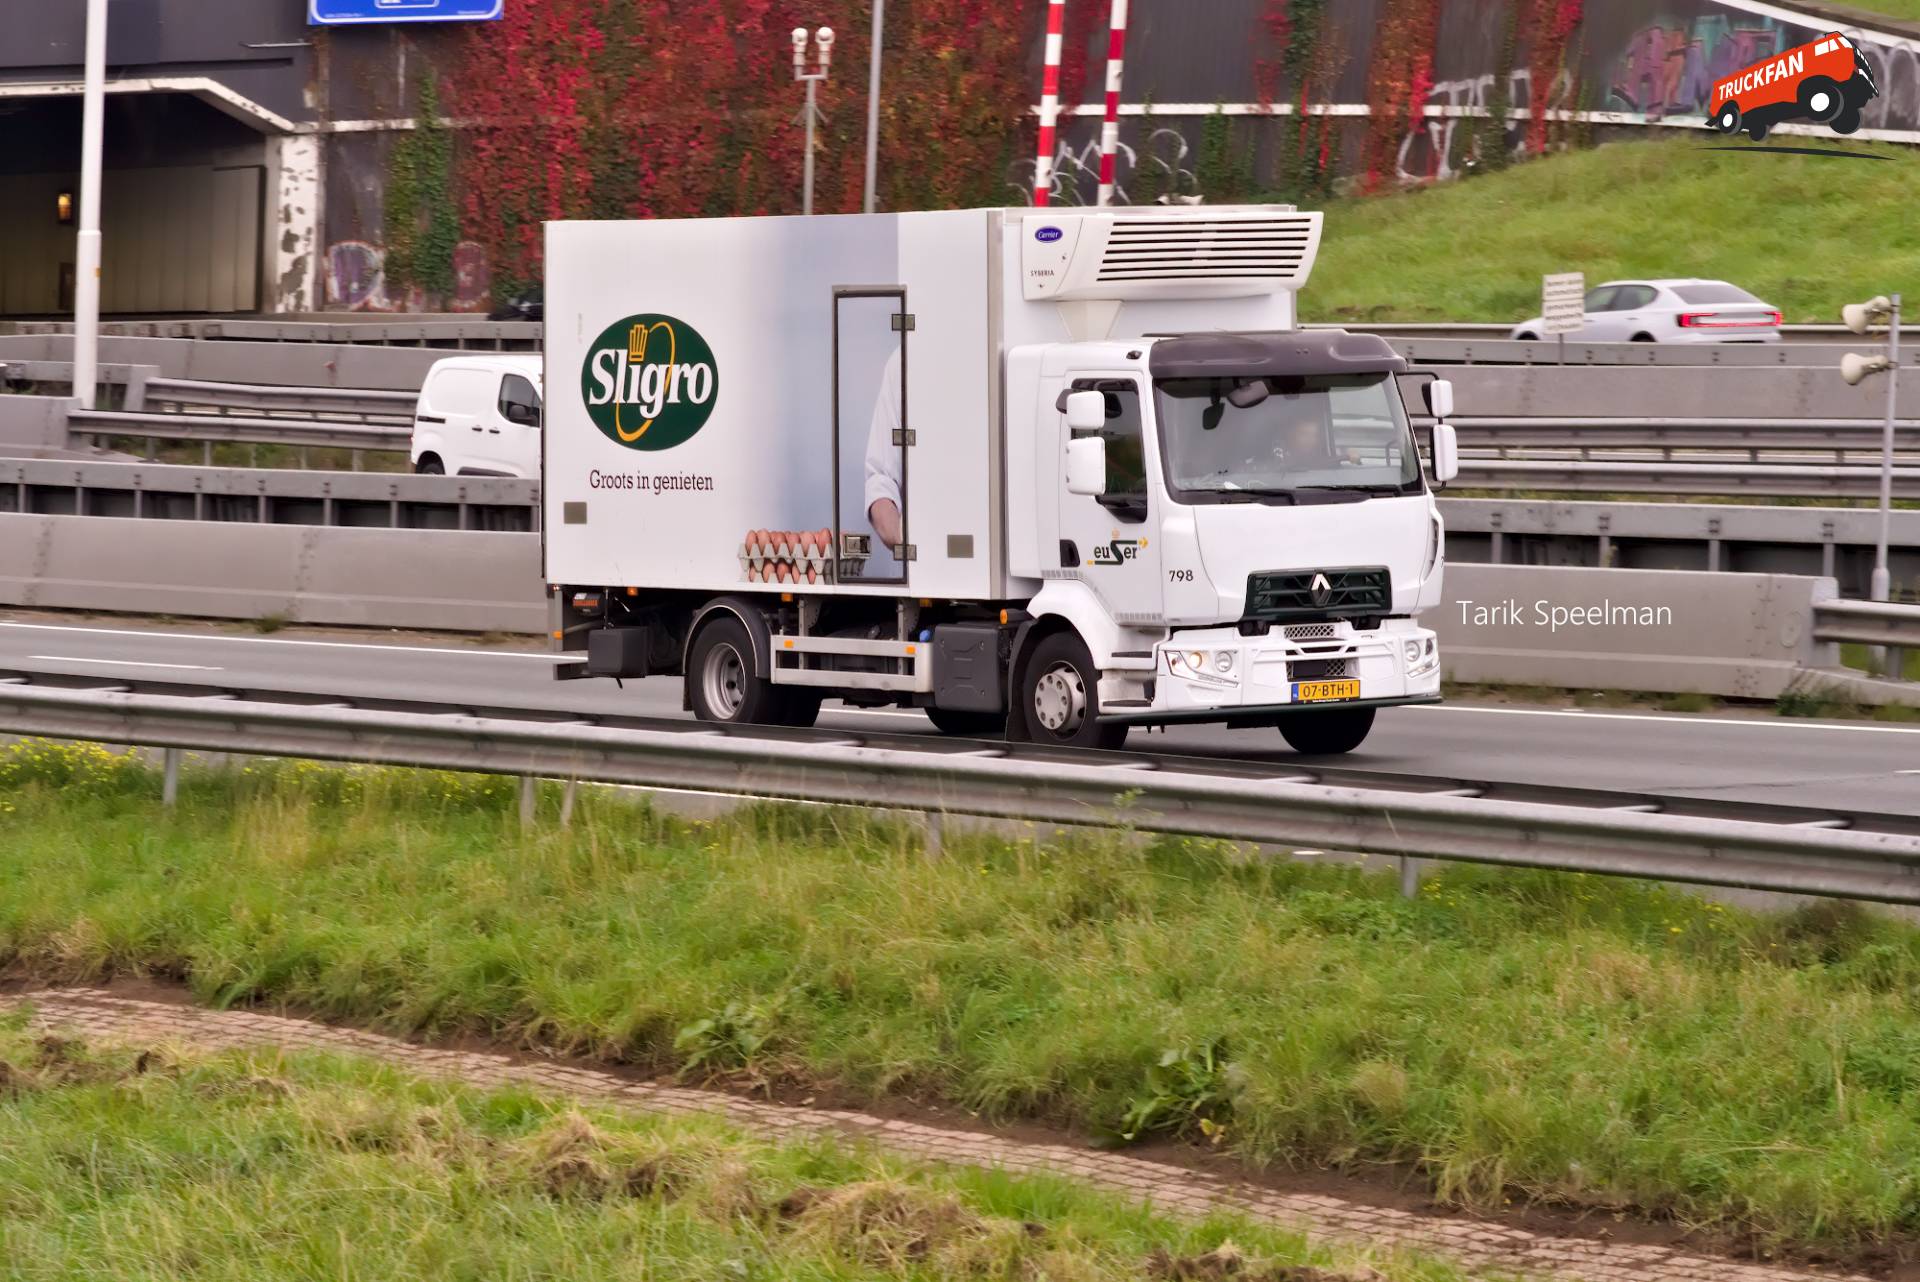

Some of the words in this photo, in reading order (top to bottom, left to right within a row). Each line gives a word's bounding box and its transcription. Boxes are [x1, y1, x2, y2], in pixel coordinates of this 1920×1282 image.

[589, 348, 713, 419] Sligro
[589, 469, 634, 489] Groots
[637, 470, 650, 489] in
[653, 471, 714, 495] genieten
[1168, 569, 1194, 582] 798
[1303, 683, 1353, 698] 07-BTH-1
